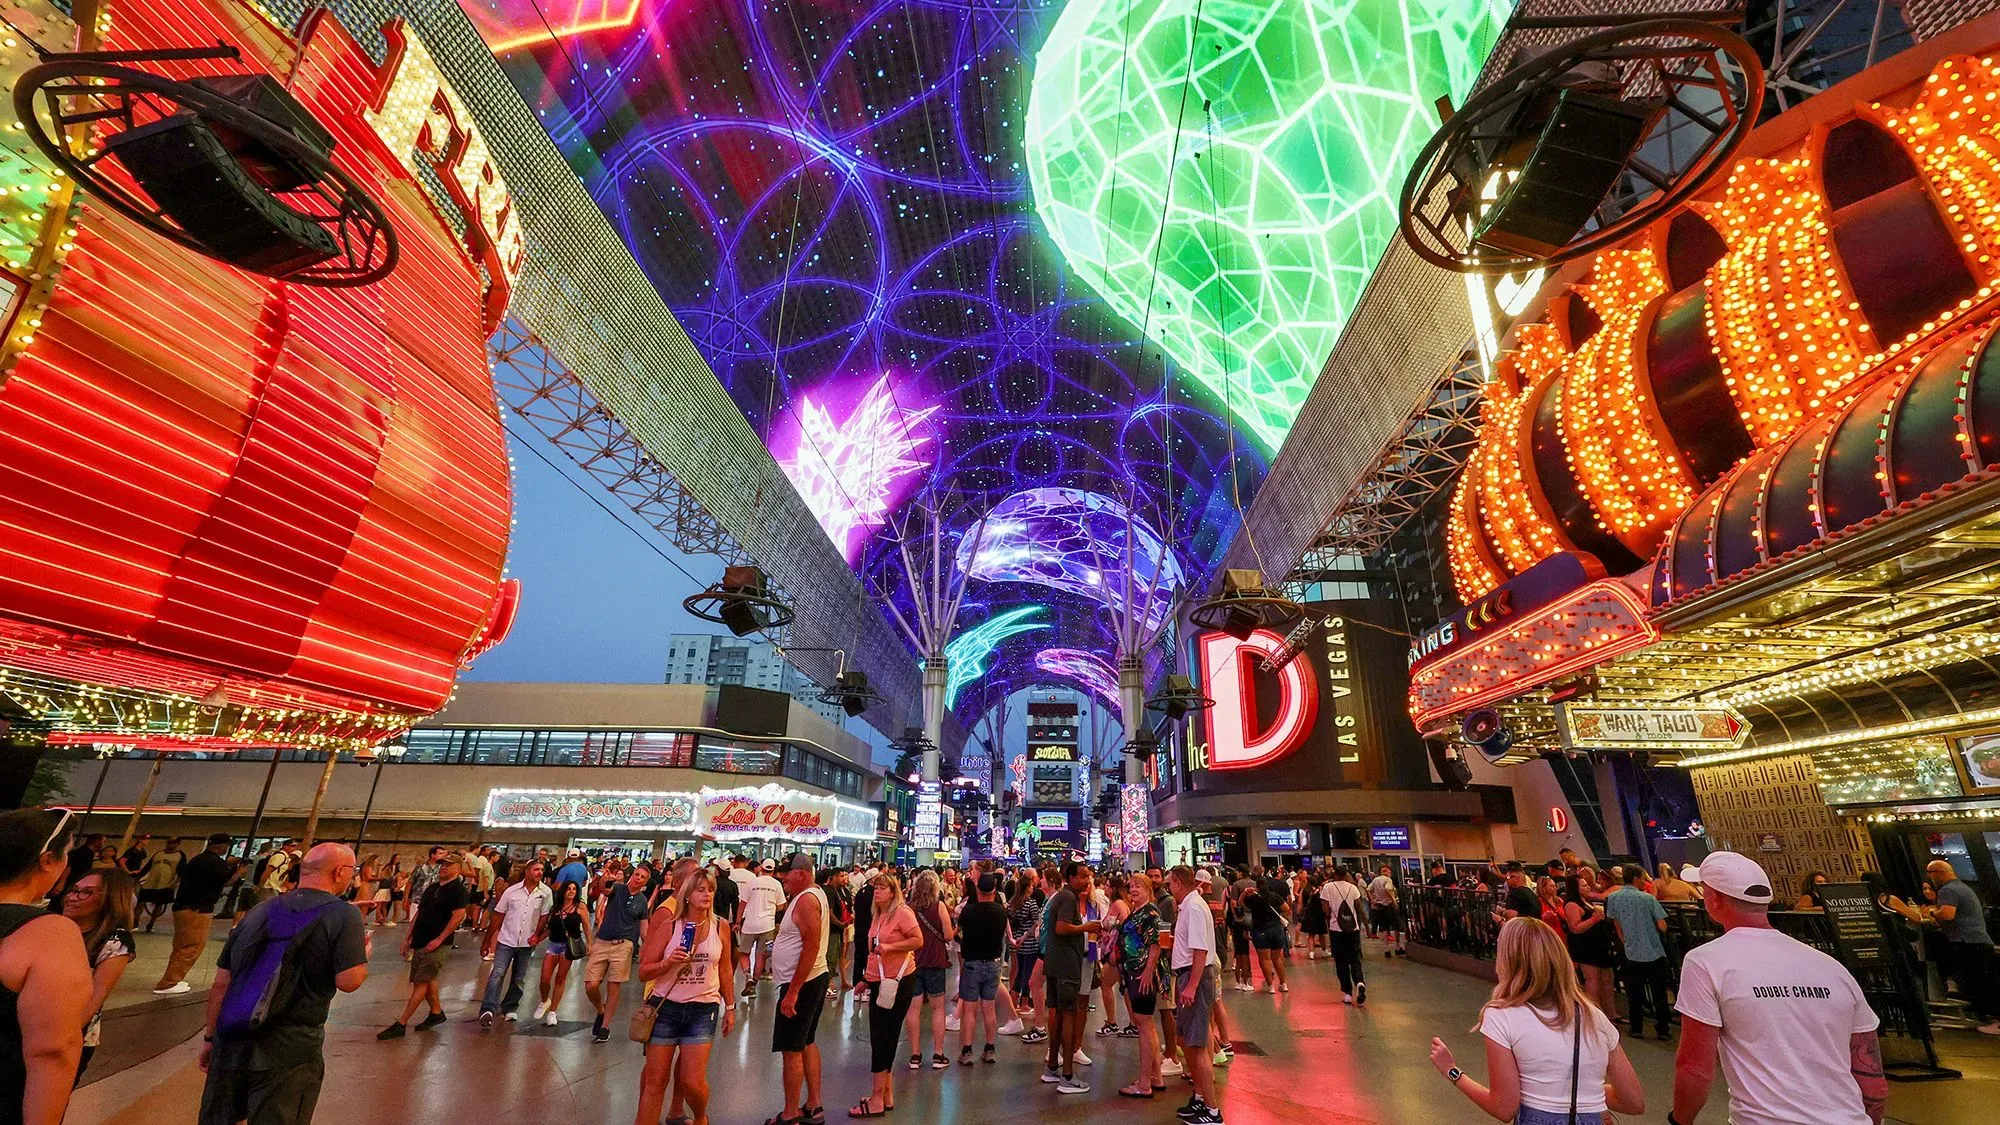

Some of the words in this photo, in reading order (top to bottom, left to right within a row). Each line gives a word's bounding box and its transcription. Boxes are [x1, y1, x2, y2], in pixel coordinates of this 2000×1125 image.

[1324, 616, 1351, 698] VEGAS
[1186, 716, 1209, 772] the
[1200, 629, 1313, 772] D
[1651, 714, 1697, 733] TACO
[1335, 715, 1359, 763] LAS
[500, 802, 556, 816] GIFTS
[558, 803, 573, 816] &
[577, 803, 686, 818] SOUVENIRS
[706, 795, 760, 809] FABULOUS
[711, 801, 757, 824] Las
[761, 804, 821, 833] Vegas
[711, 824, 768, 832] JEWELRY
[797, 827, 829, 835] GIFTS
[1825, 898, 1838, 906] NO
[1839, 897, 1872, 906] OUTSIDE
[1752, 986, 1790, 998] DOUBLE
[1792, 986, 1831, 999] CHAMP
